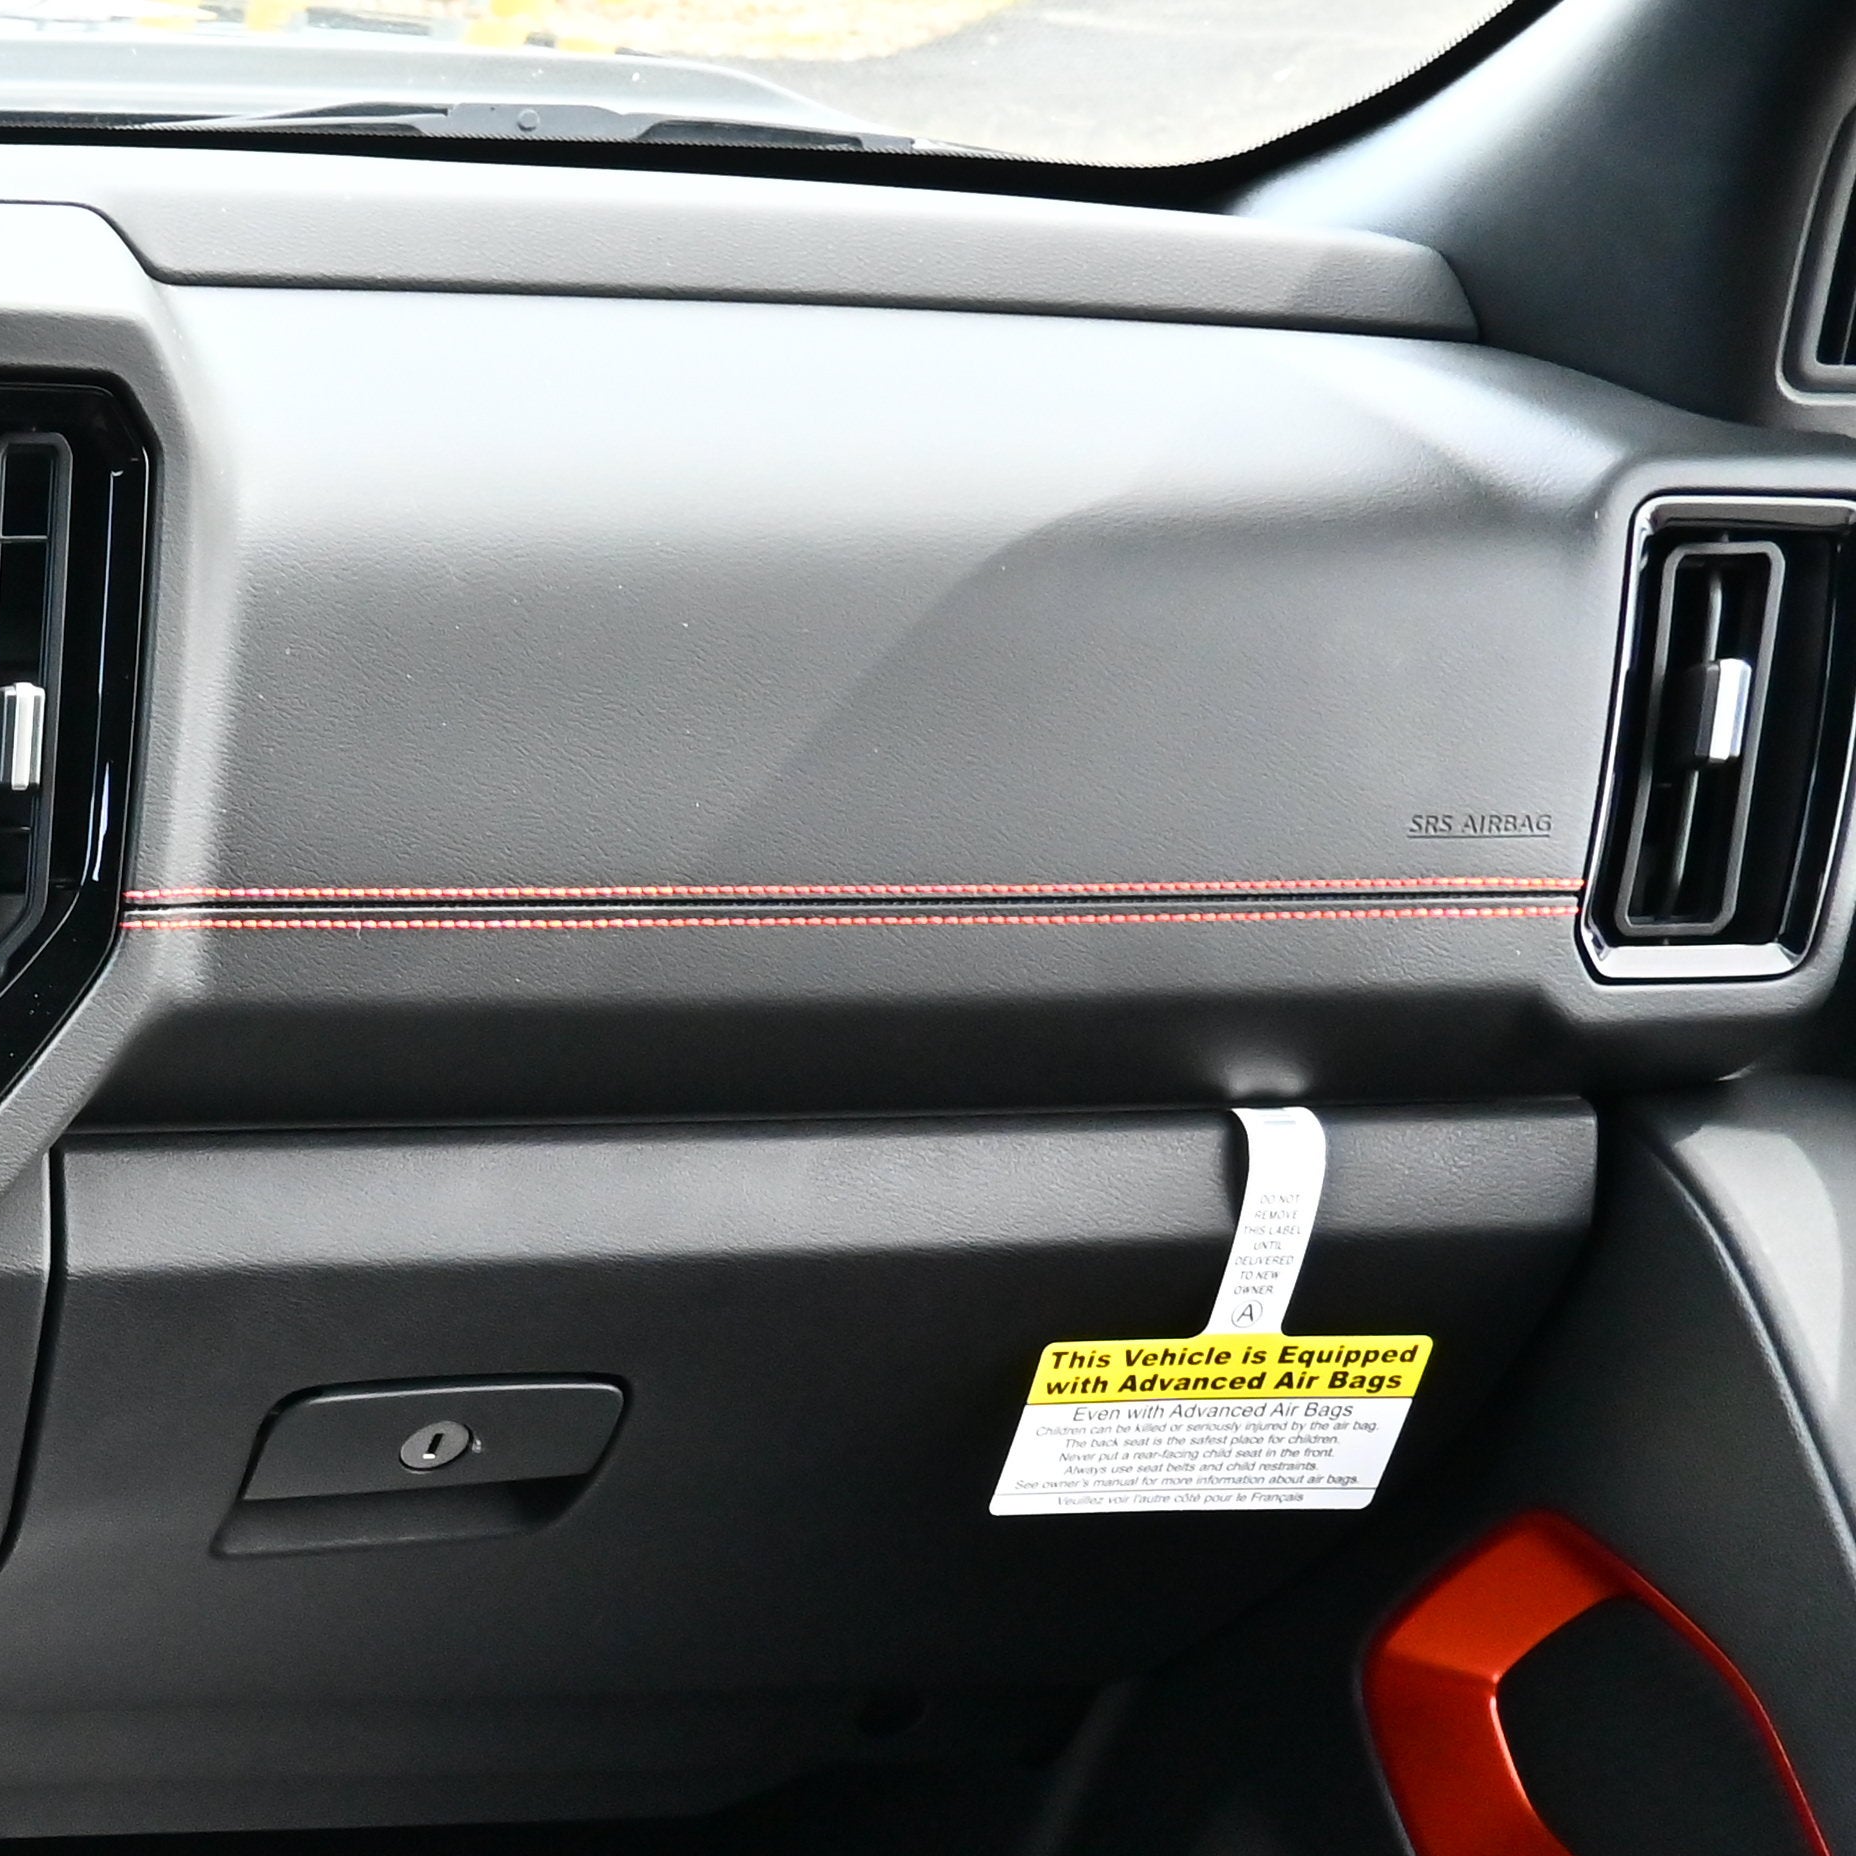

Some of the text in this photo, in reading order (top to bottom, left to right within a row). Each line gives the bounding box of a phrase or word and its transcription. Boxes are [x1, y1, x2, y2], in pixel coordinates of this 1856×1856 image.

[1409, 813, 1552, 833] SRS AIRBAG
[1254, 1210, 1298, 1220] REMOVE
[1244, 1226, 1301, 1235] THIS LABEL
[1254, 1241, 1281, 1250] UNTIL
[1235, 1255, 1294, 1265] DELIVERED
[1241, 1271, 1279, 1280] TO NEW
[1234, 1285, 1273, 1295] OWNER
[1237, 1303, 1254, 1322] A
[1052, 1344, 1419, 1370] This Vehicle is Equipped
[1046, 1370, 1402, 1395] with Advanced Air Bags
[1073, 1401, 1354, 1422] Even with Advanced Air Bags
